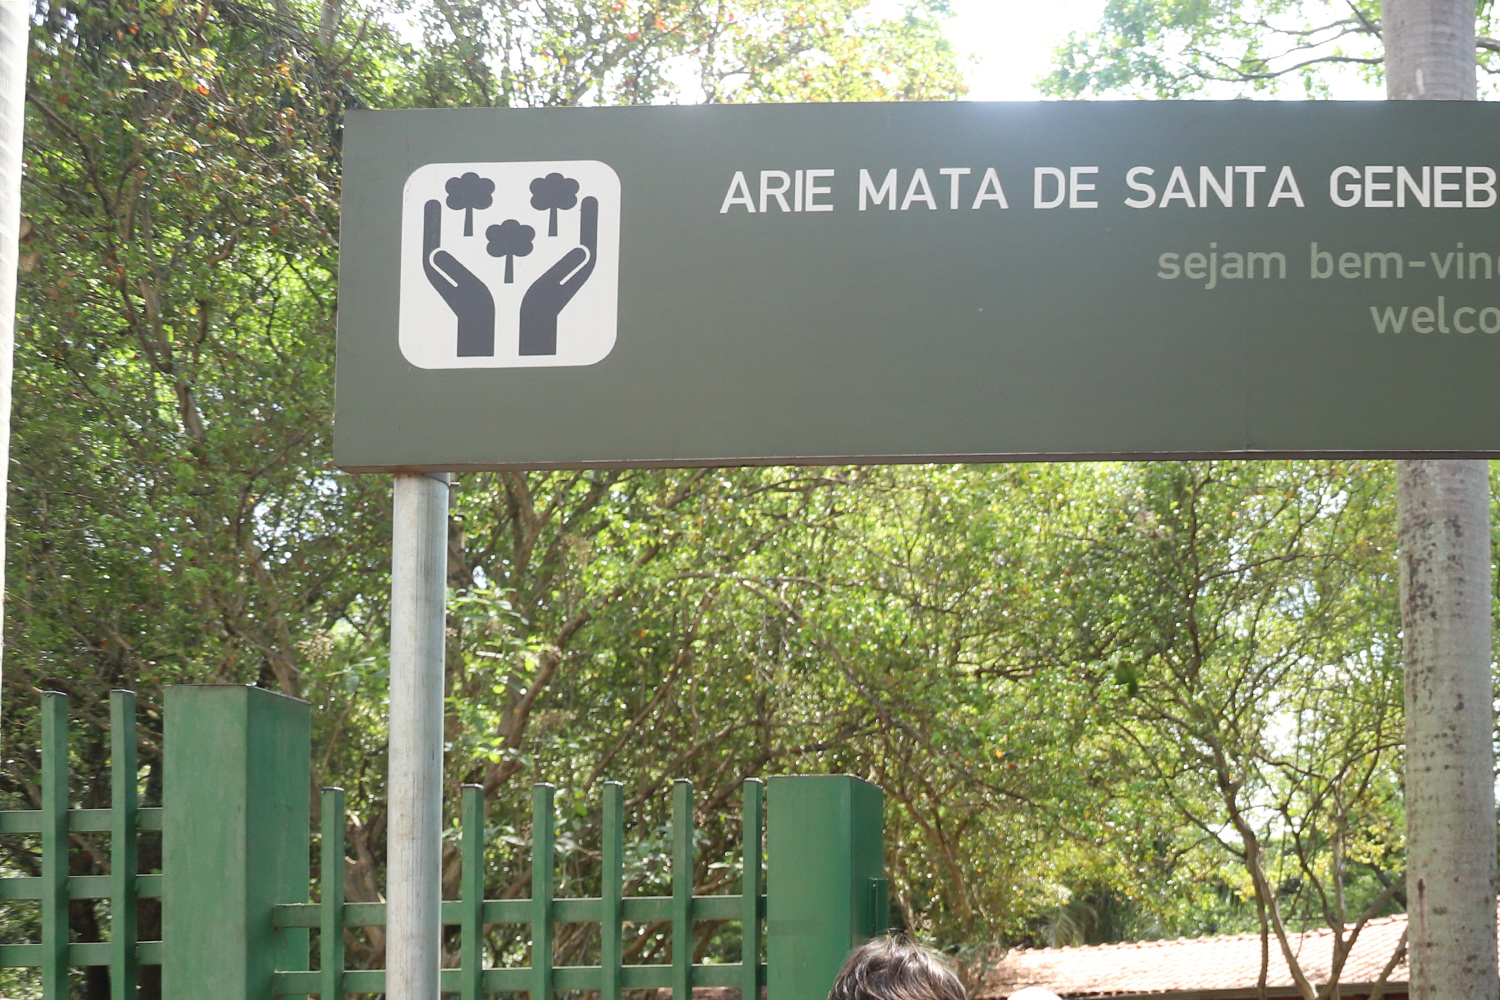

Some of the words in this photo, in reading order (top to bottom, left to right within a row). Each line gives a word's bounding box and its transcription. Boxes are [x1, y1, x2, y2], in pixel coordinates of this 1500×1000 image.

[719, 168, 835, 214] ARIE
[858, 167, 1008, 212] MATA
[1034, 166, 1099, 209] DE
[1124, 165, 1305, 209] SANTA
[1156, 241, 1287, 290] sejam
